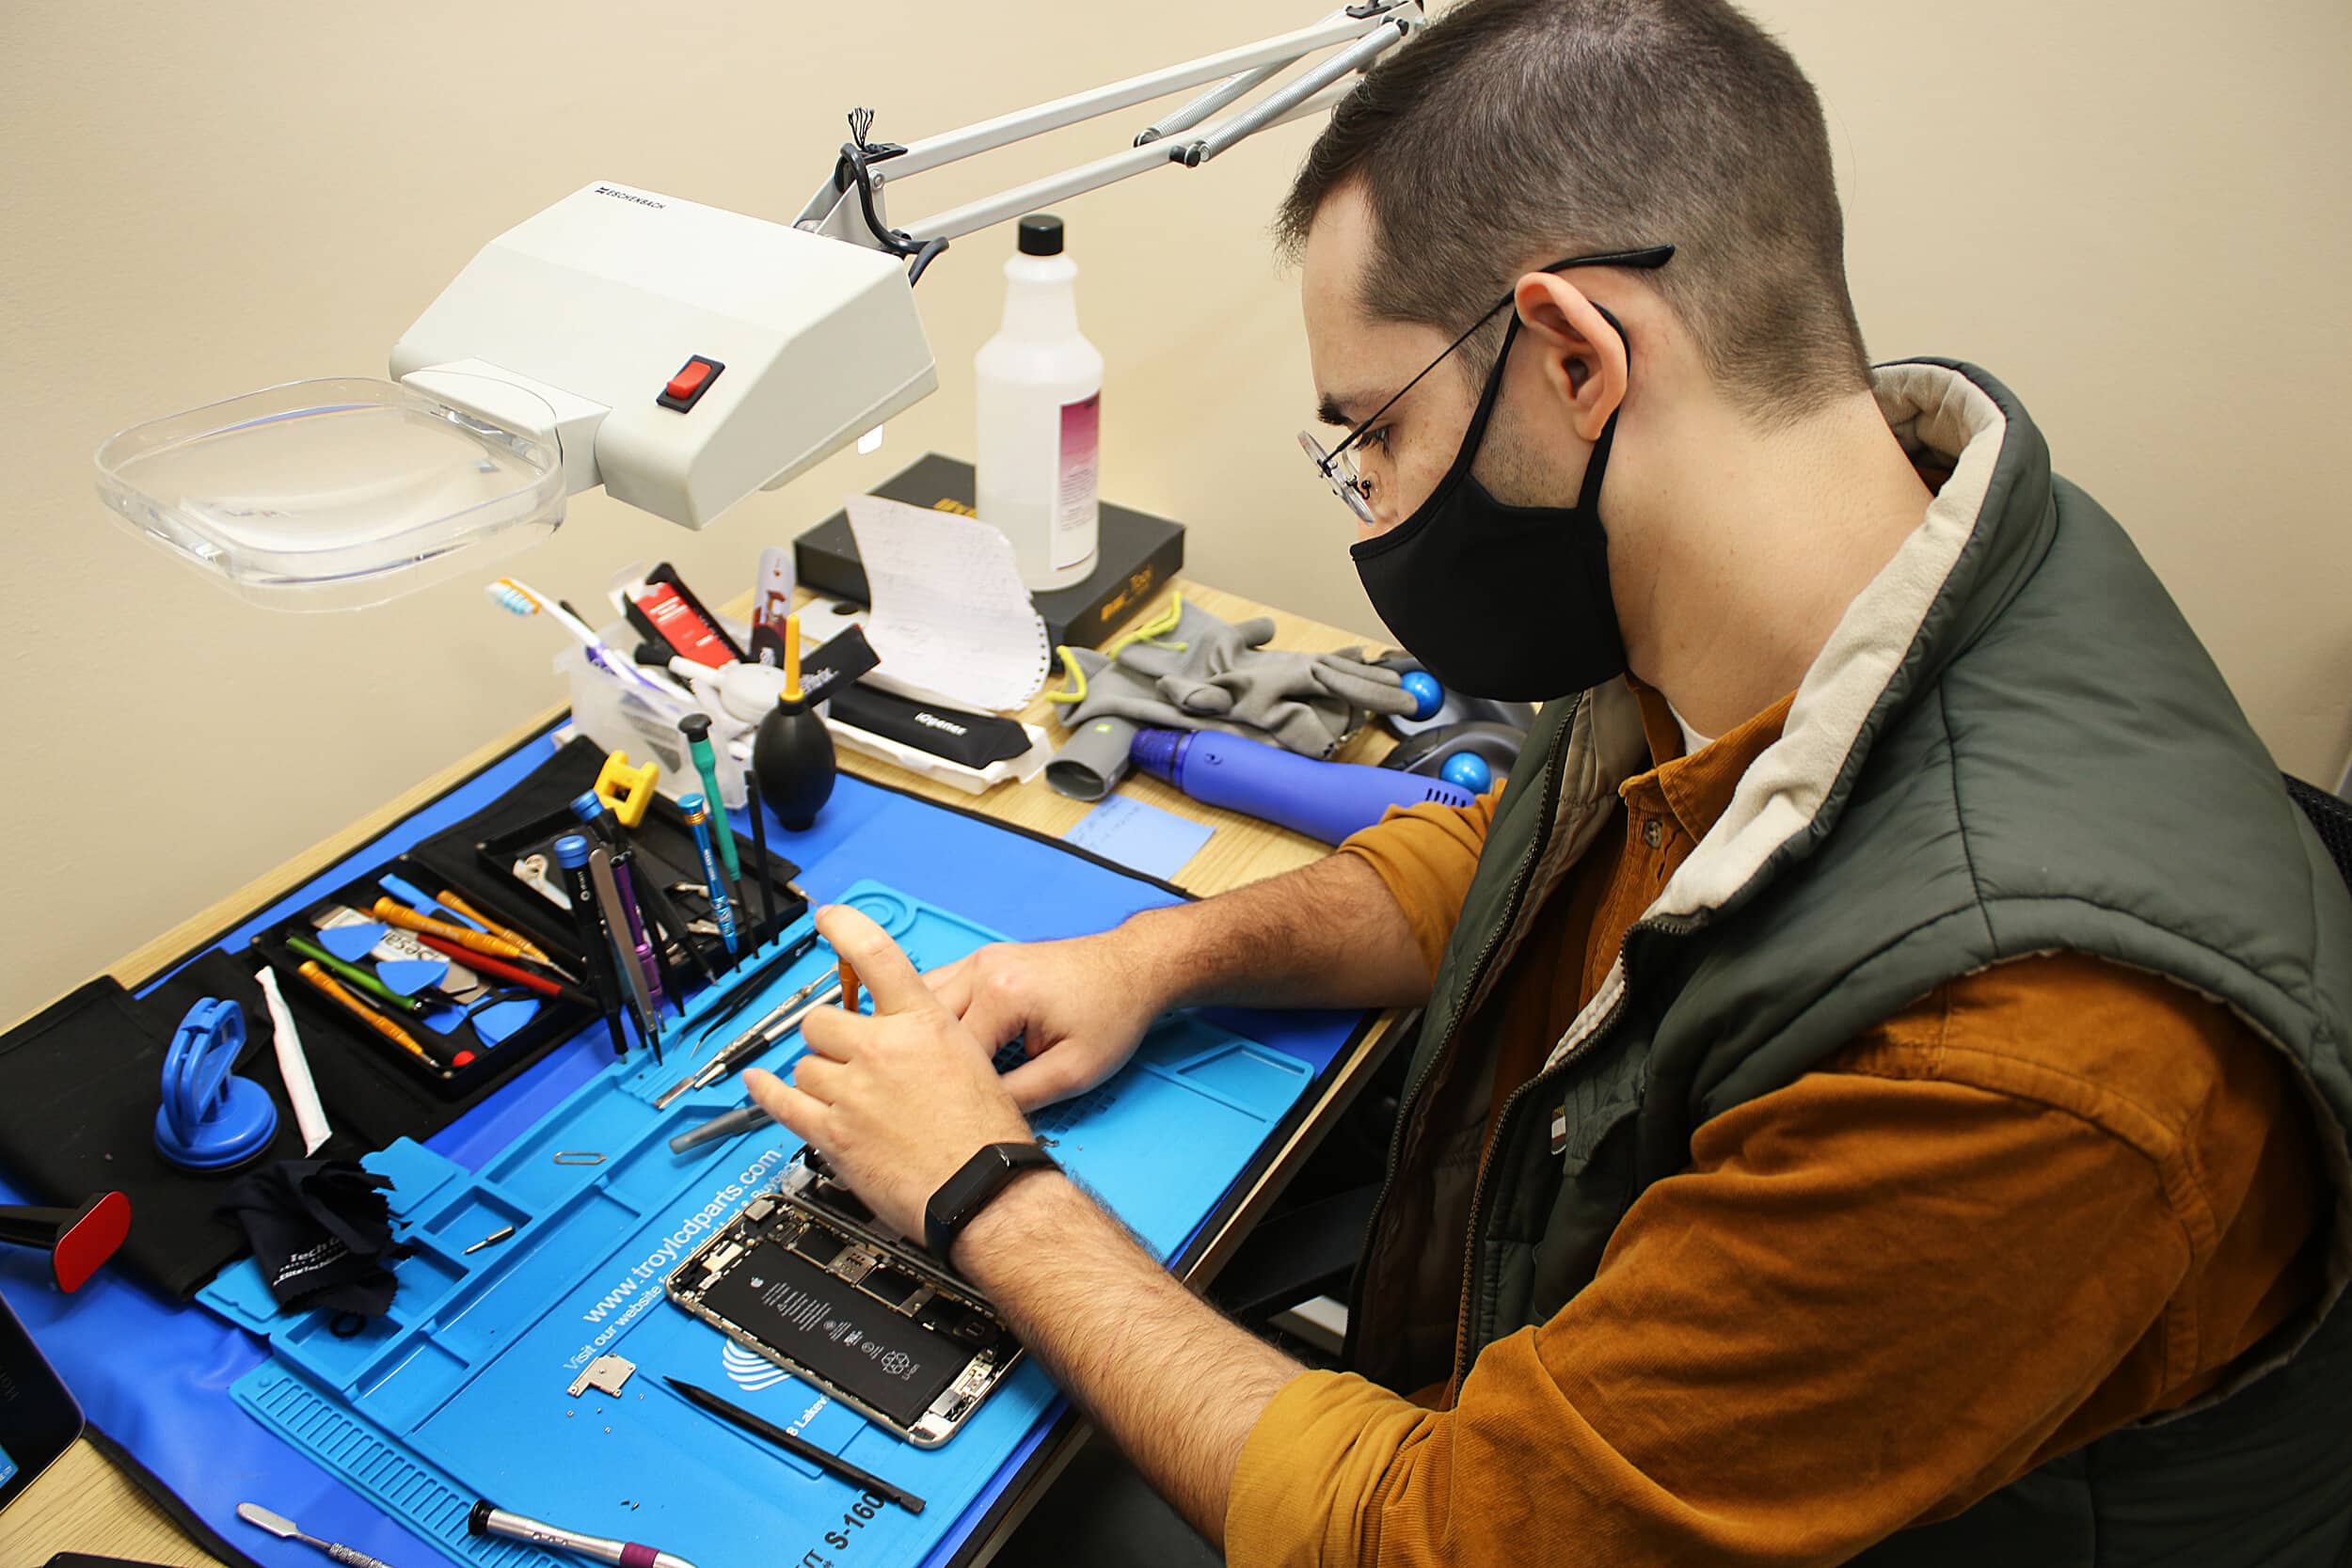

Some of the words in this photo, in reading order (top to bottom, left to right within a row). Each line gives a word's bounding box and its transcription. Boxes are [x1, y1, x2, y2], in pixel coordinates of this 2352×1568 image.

[606, 190, 666, 209] ESCHENBACH
[914, 712, 967, 736] iOpener
[583, 1148, 783, 1324] www.troylcdparts.com
[564, 1343, 597, 1370] Visit
[594, 1325, 617, 1346] our
[614, 1285, 662, 1327] website
